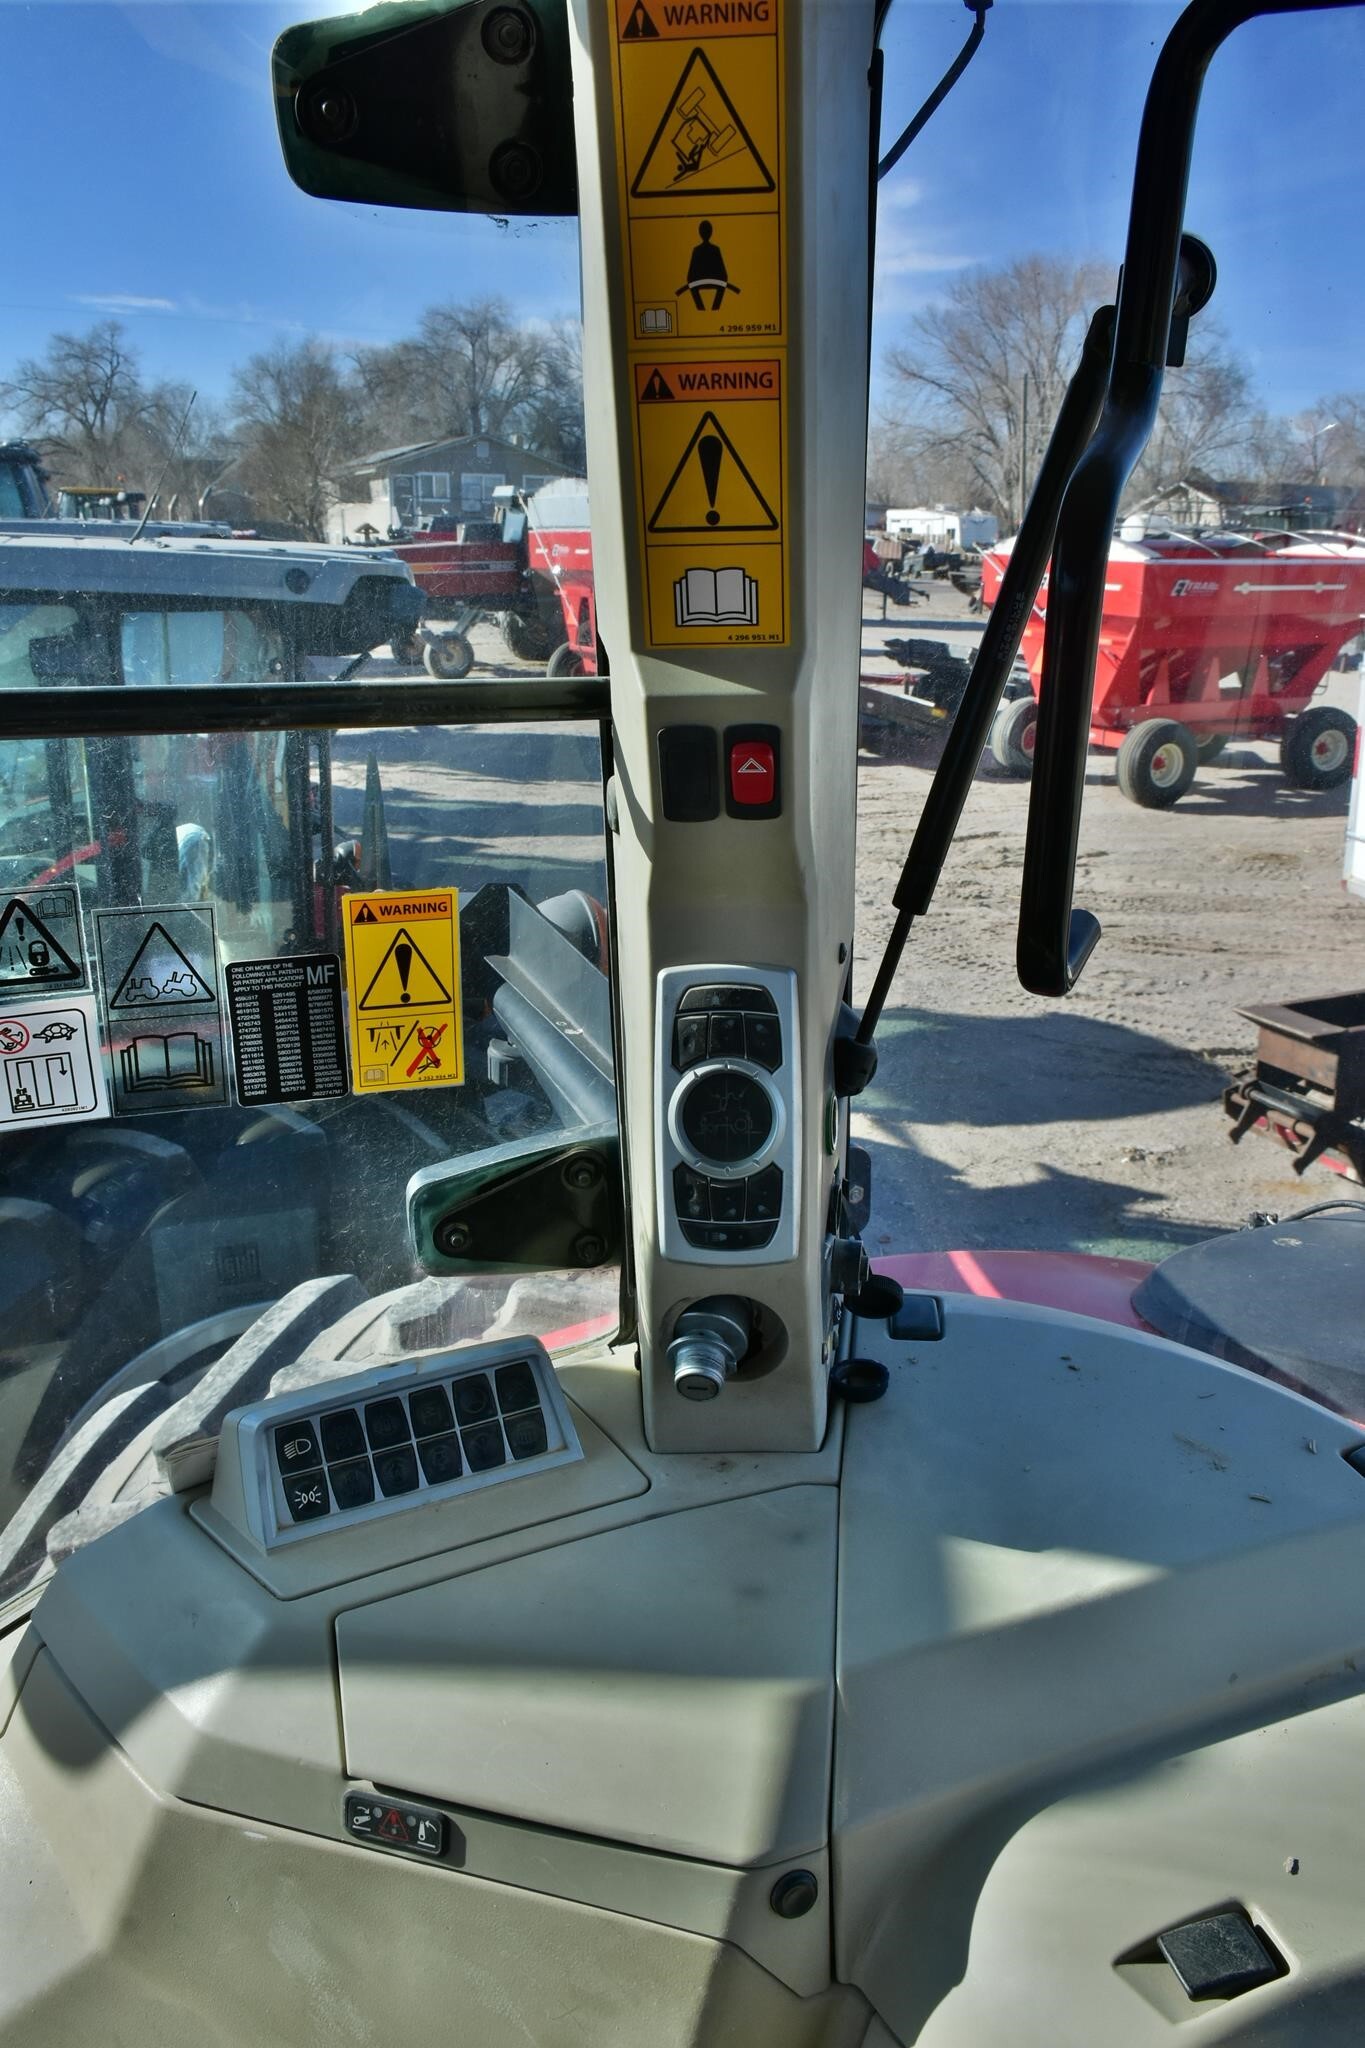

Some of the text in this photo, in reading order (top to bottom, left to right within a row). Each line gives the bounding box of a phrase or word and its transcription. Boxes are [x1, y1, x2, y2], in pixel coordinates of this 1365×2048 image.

[663, 1, 769, 26] WARNING
[764, 323, 776, 331] M1
[678, 371, 773, 391] WARNING
[379, 901, 448, 916] WARNING
[232, 972, 266, 980] FOLLOWING
[278, 968, 304, 976] PATENTS
[264, 974, 304, 984] APPLICATIONS
[306, 964, 335, 986] MF
[274, 981, 302, 989] PRODUCT
